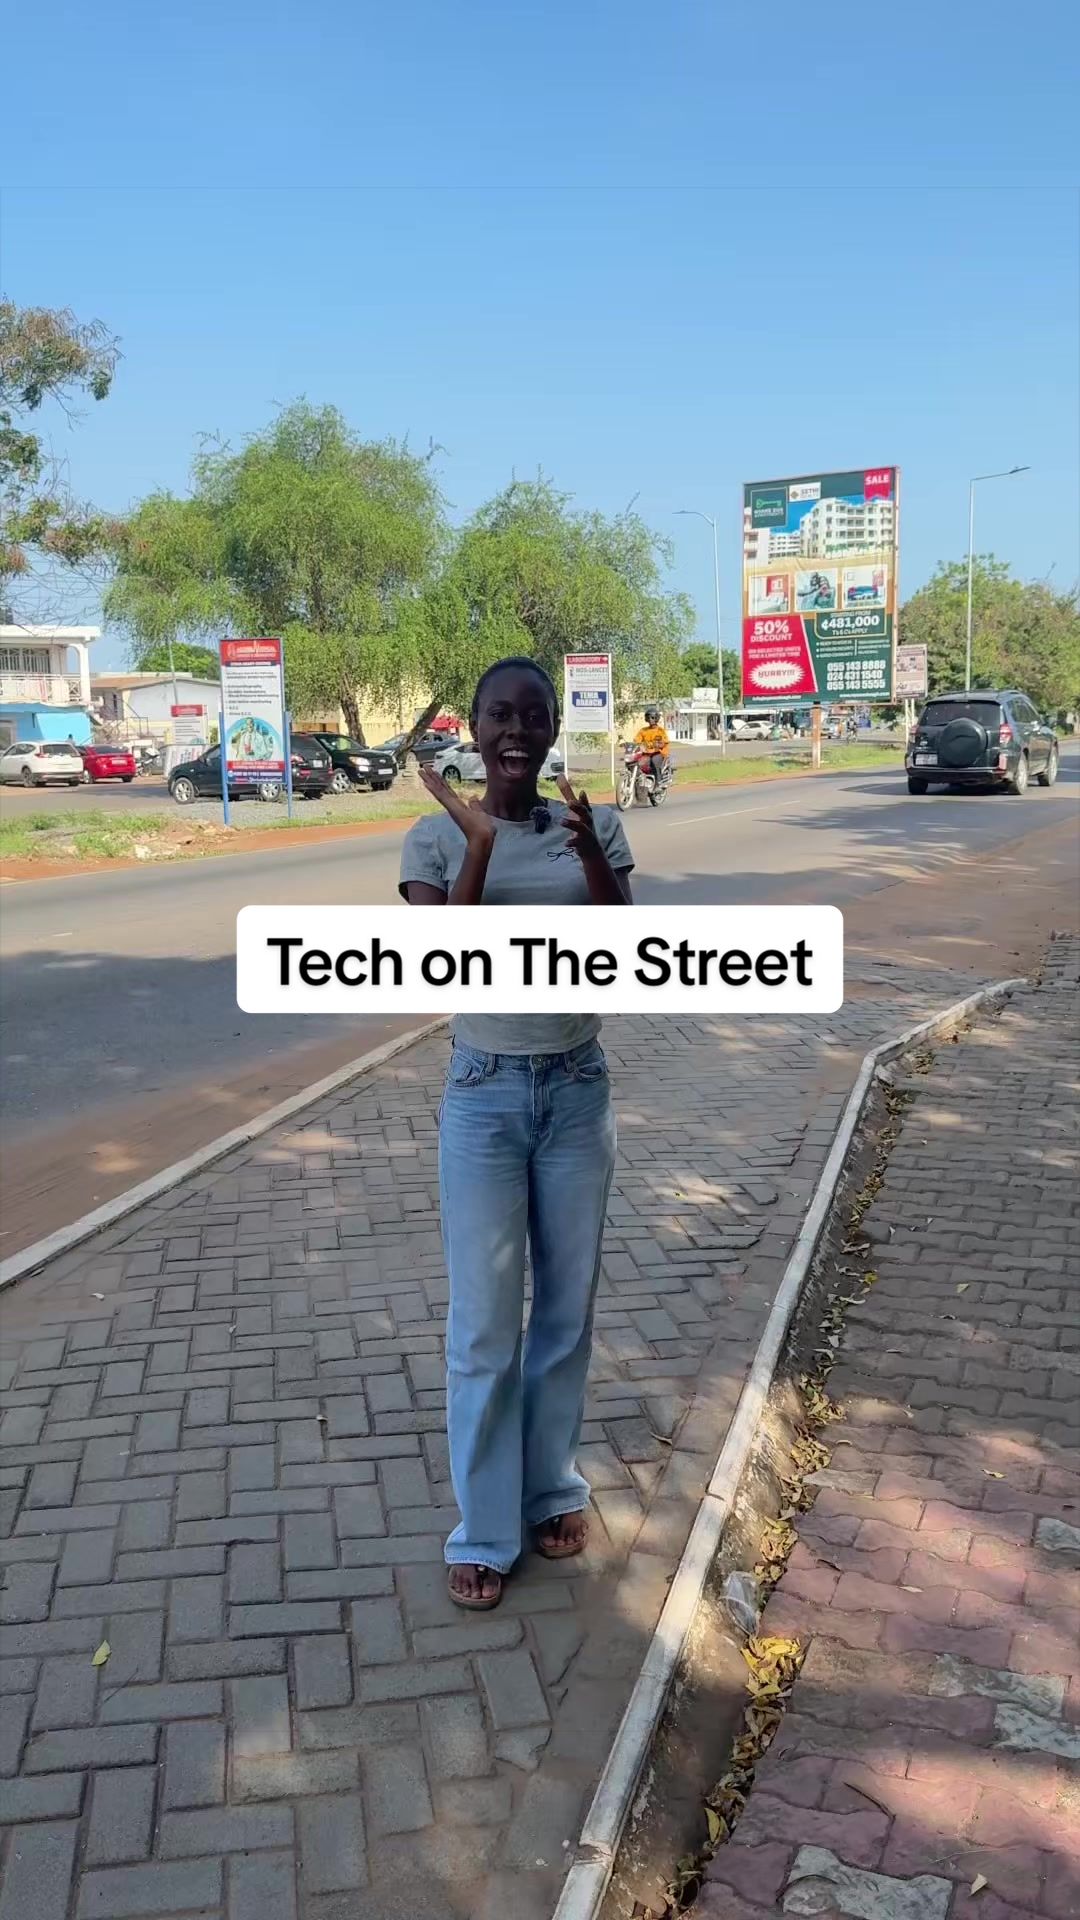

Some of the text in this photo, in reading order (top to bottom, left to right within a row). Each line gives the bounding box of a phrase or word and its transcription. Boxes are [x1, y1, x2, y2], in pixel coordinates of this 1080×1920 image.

[865, 475, 889, 485] SALE
[754, 619, 789, 635] 50%
[750, 633, 792, 643] DISCOUNT
[827, 662, 844, 671] 055
[846, 661, 860, 671] 143
[827, 669, 883, 681] 024 431 1540
[827, 681, 844, 691] 055
[845, 680, 860, 690] 143
